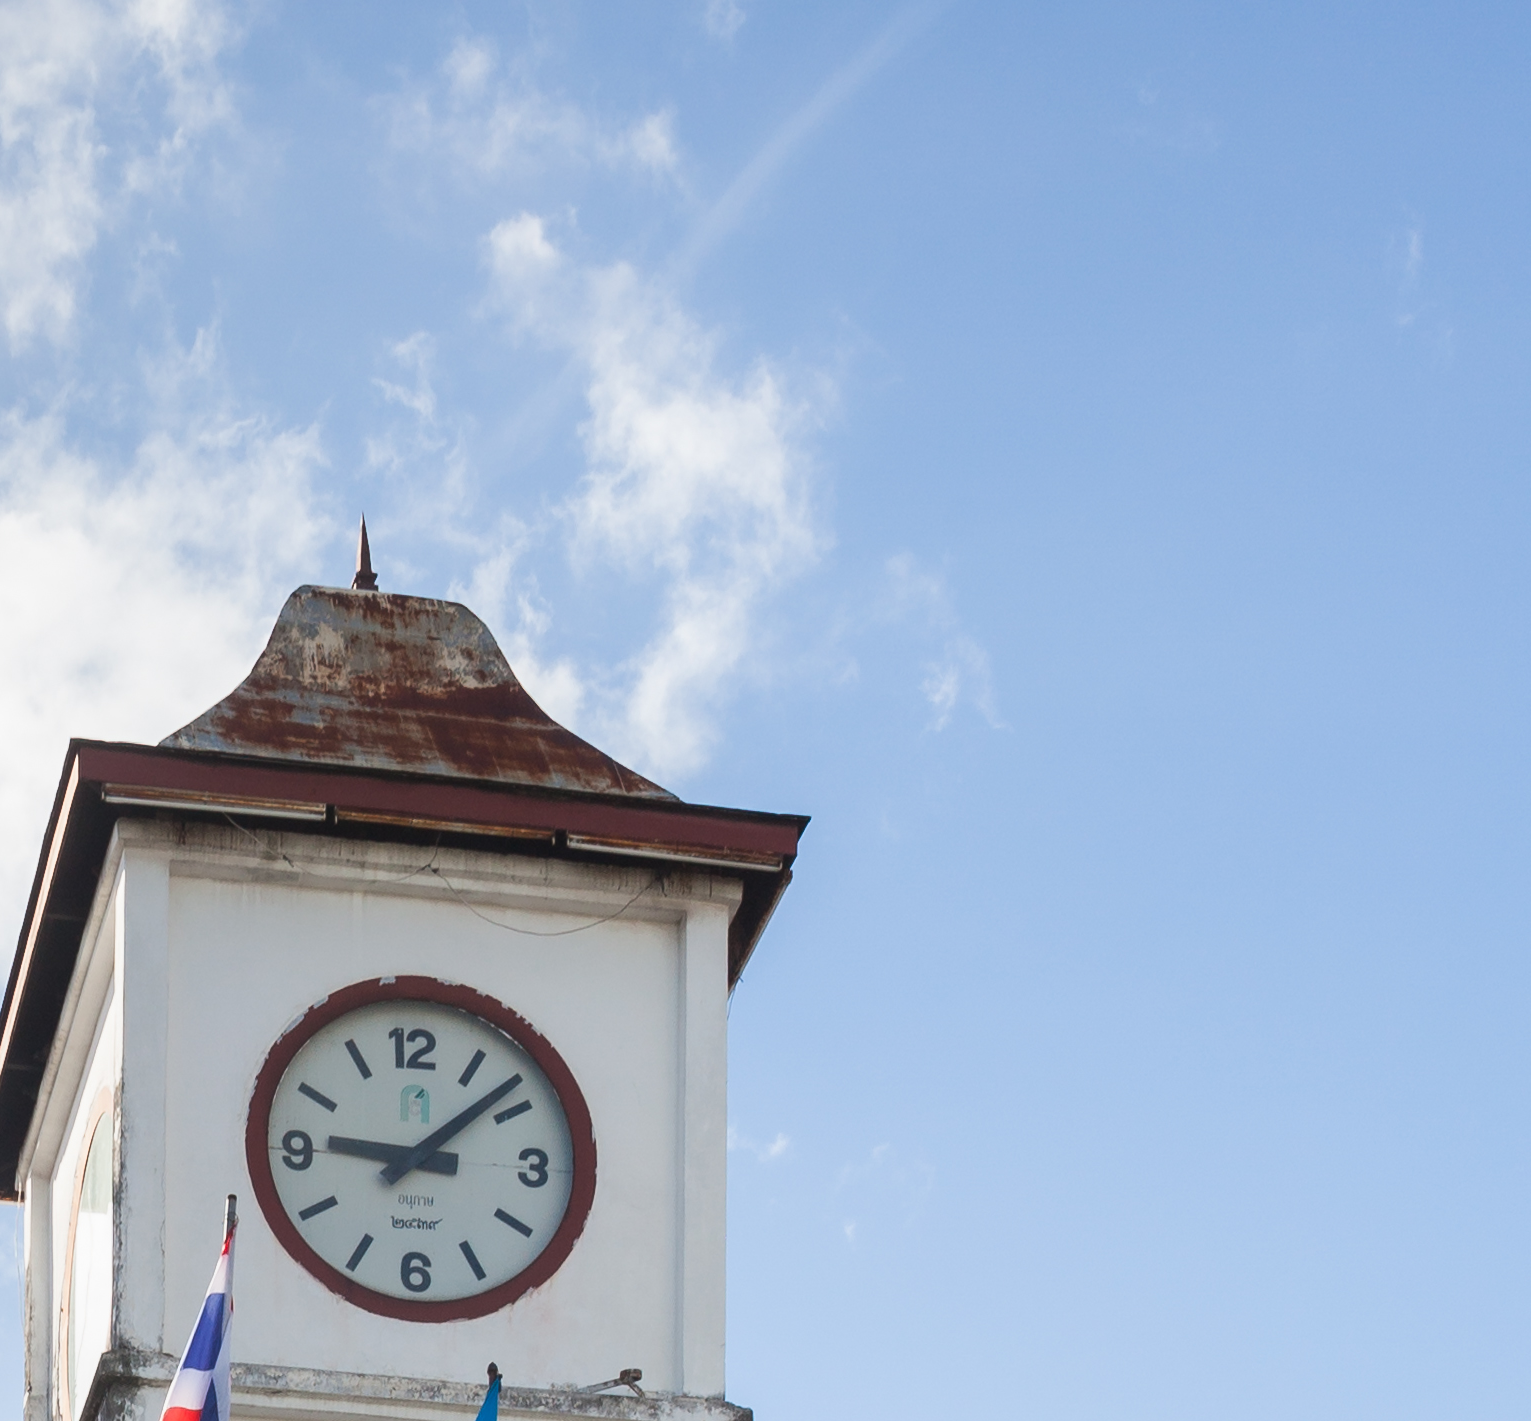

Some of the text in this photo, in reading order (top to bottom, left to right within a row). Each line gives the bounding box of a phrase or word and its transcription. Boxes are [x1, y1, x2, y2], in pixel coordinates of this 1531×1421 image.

[388, 1026, 437, 1071] 12
[281, 1130, 314, 1171] 9
[517, 1147, 550, 1188] 3
[400, 1251, 432, 1293] 6
